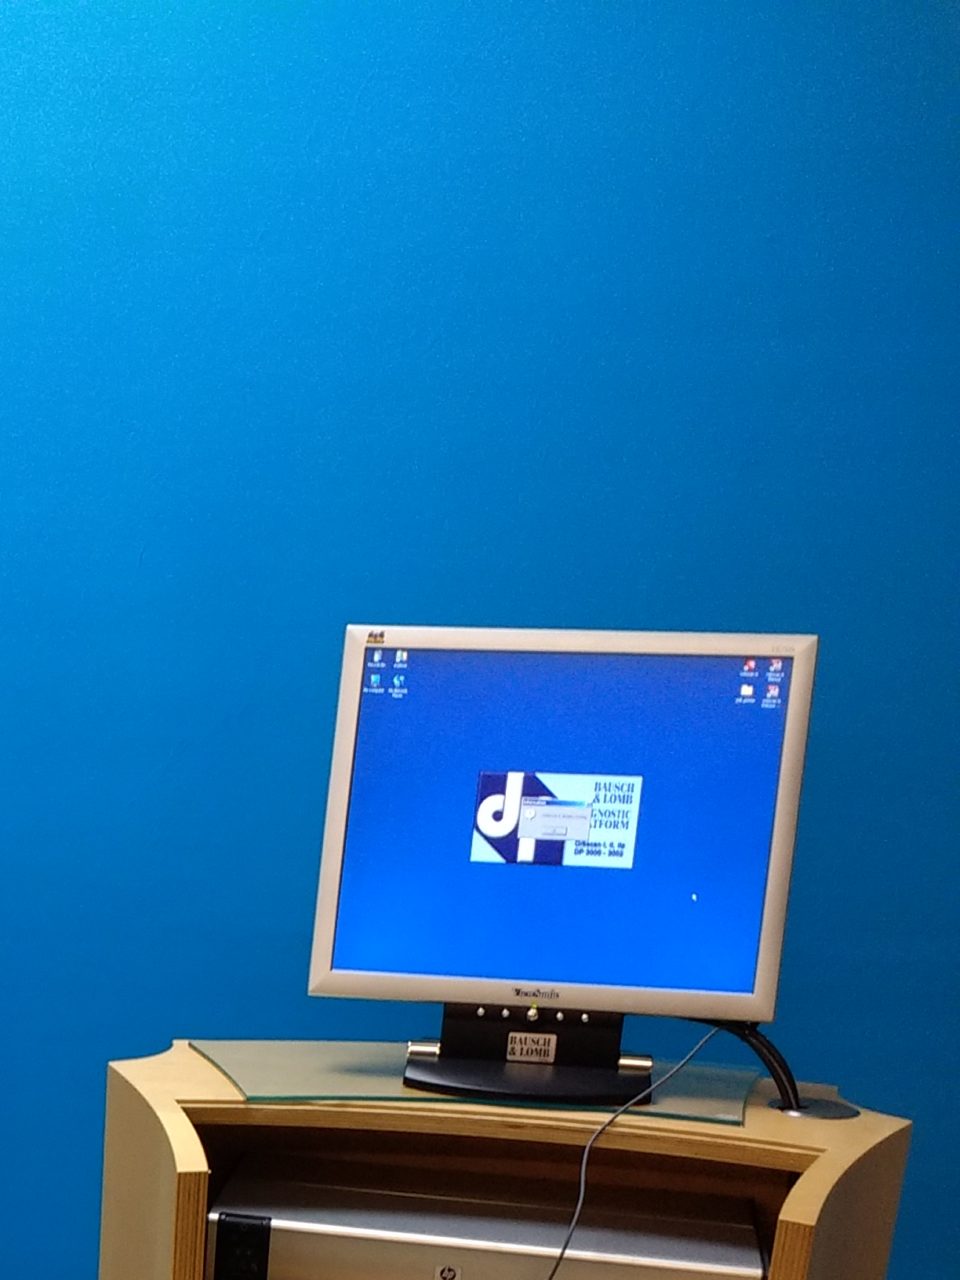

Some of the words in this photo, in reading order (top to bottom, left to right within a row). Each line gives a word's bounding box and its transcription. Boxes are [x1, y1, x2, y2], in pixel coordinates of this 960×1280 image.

[594, 781, 635, 793] BAUSCH
[603, 793, 633, 805] LOMB
[590, 808, 631, 819] GNOSTIC
[509, 1035, 551, 1047] BAUSCH
[519, 1046, 550, 1058] LOMB
